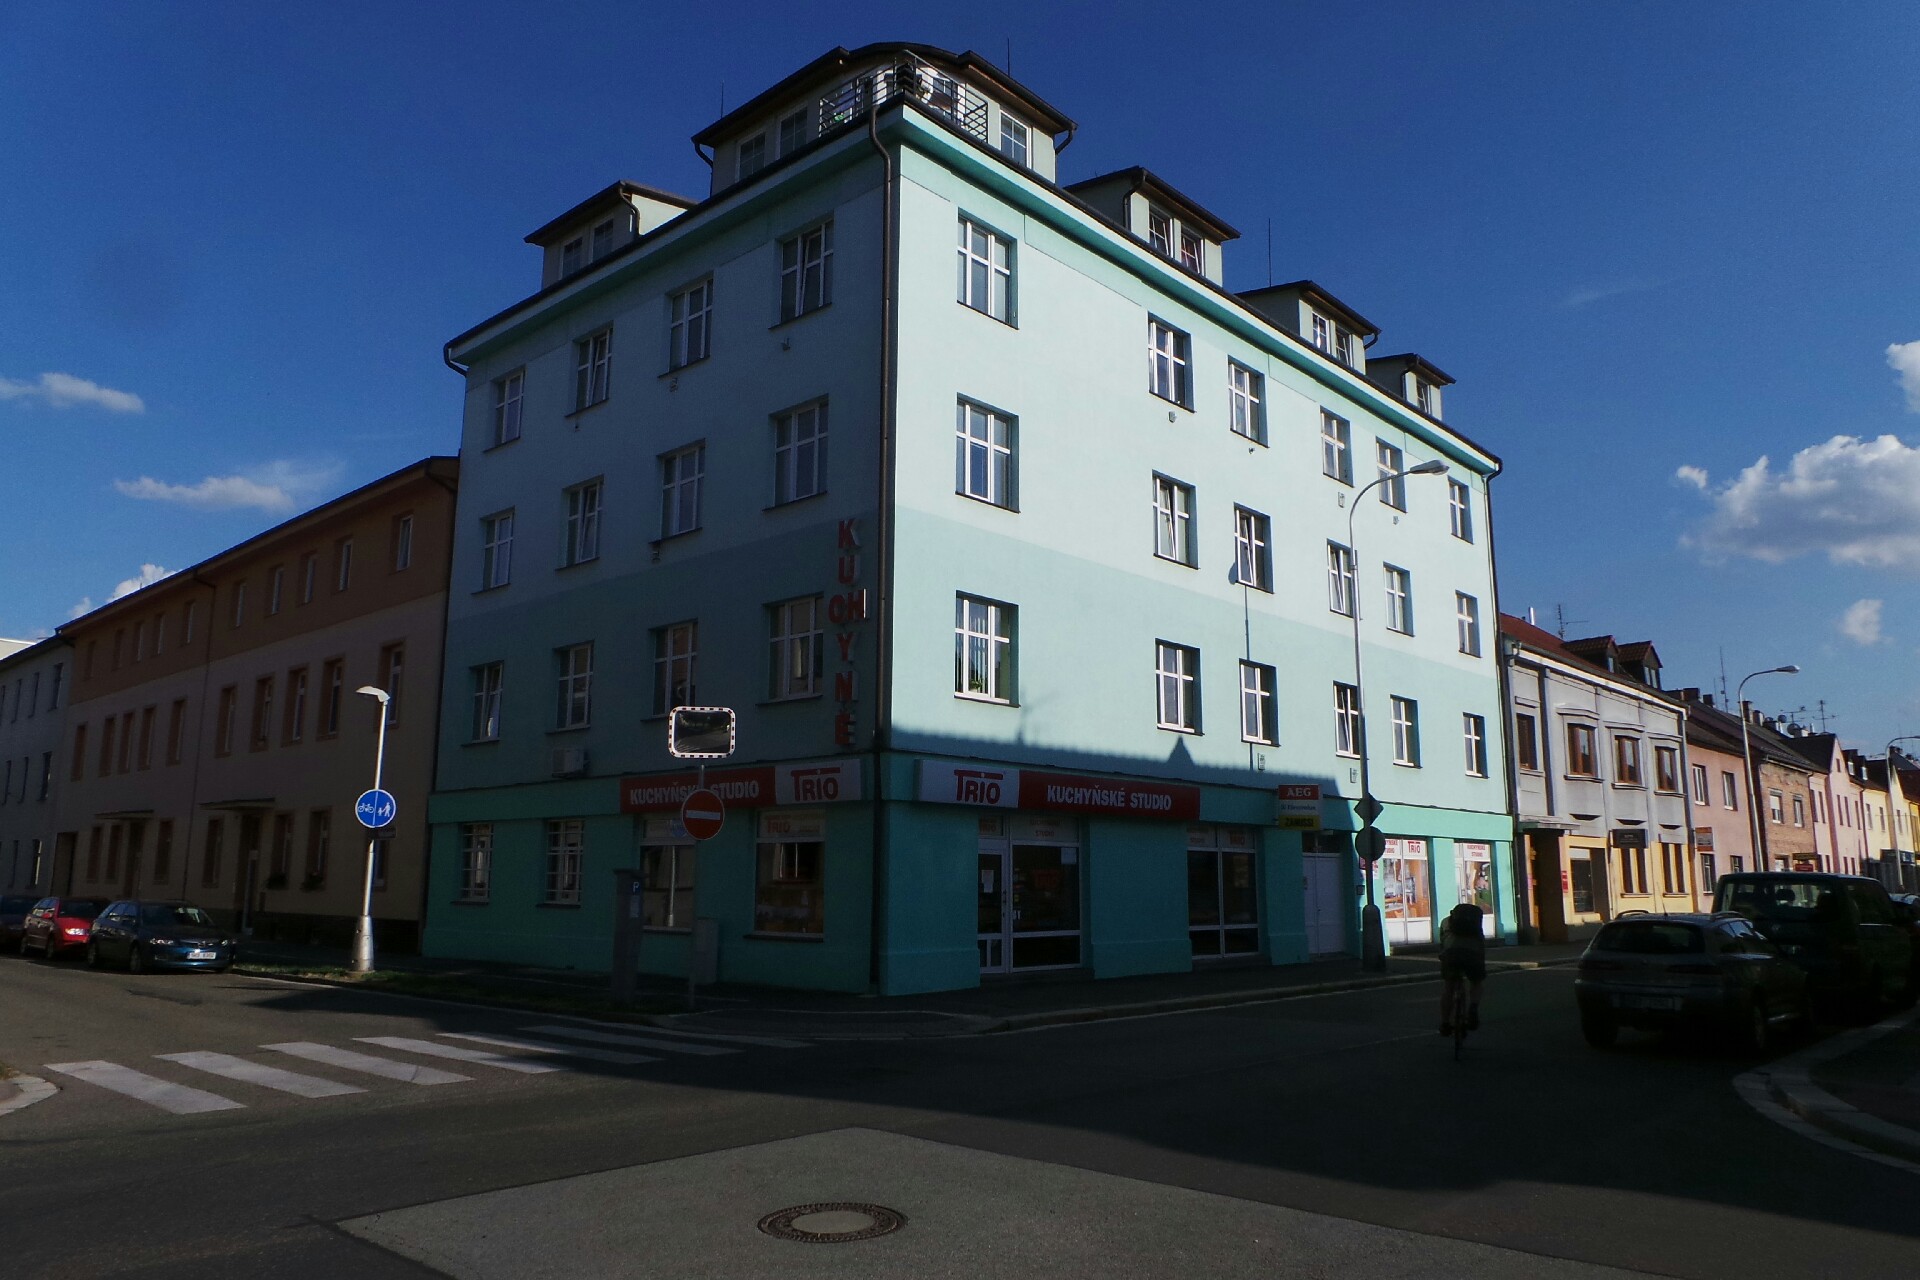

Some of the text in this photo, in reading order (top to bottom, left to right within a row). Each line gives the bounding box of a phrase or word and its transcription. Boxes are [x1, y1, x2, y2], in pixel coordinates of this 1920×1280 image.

[710, 779, 760, 800] STUDIO
[790, 767, 840, 801] TRIO
[954, 769, 1004, 804] TRIO
[1047, 784, 1172, 811] KUCHYŇSKÉ STUDIO
[1286, 787, 1312, 797] AEG
